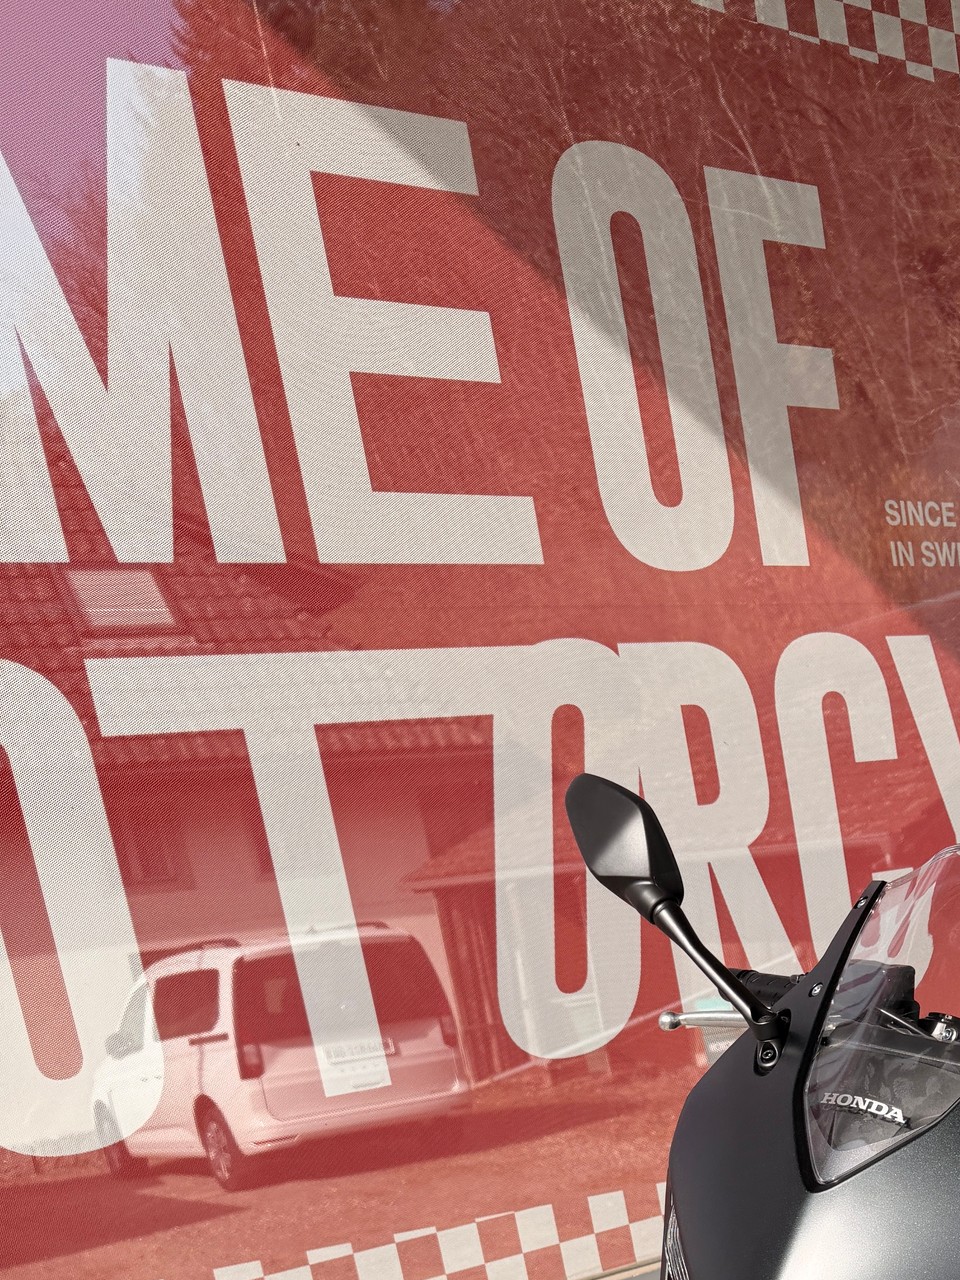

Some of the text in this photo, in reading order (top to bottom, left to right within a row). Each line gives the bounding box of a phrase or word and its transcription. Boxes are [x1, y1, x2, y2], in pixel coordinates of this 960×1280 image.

[551, 139, 840, 572] OF
[884, 499, 957, 528] SINCE
[889, 540, 915, 567] IN
[820, 1091, 907, 1124] HONDA
